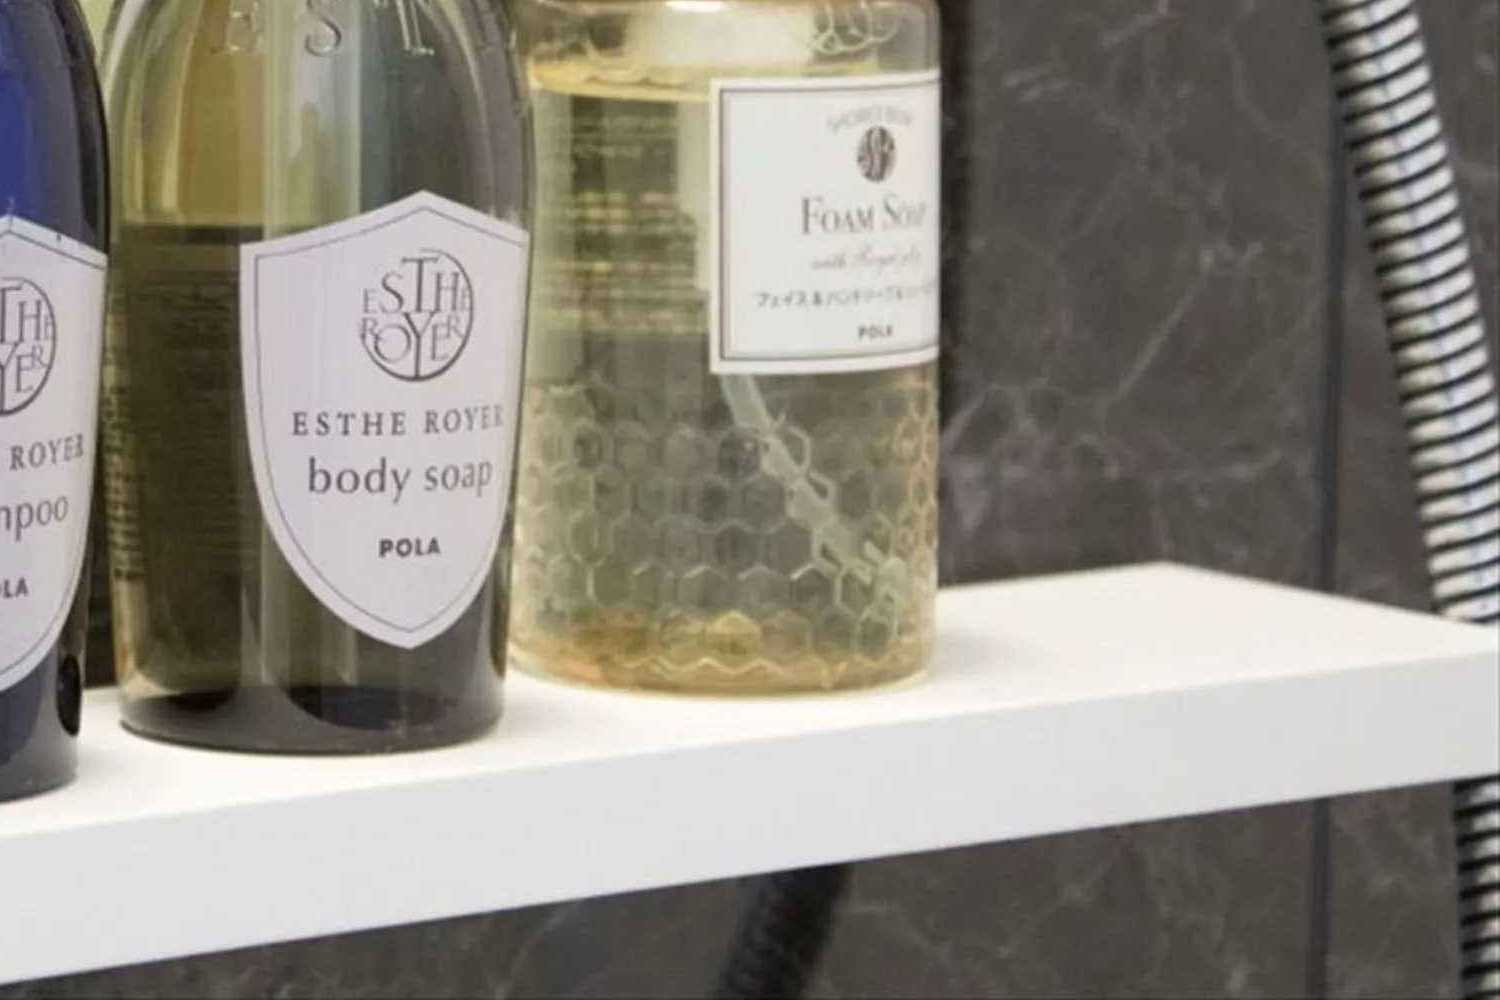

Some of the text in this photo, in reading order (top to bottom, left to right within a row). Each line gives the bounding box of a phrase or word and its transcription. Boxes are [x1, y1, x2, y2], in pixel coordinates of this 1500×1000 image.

[856, 323, 895, 341] POLA
[291, 403, 504, 438] ESTHE ROYER
[9, 432, 85, 471] ROYER
[307, 455, 493, 505] body soap
[378, 536, 442, 559] POLA
